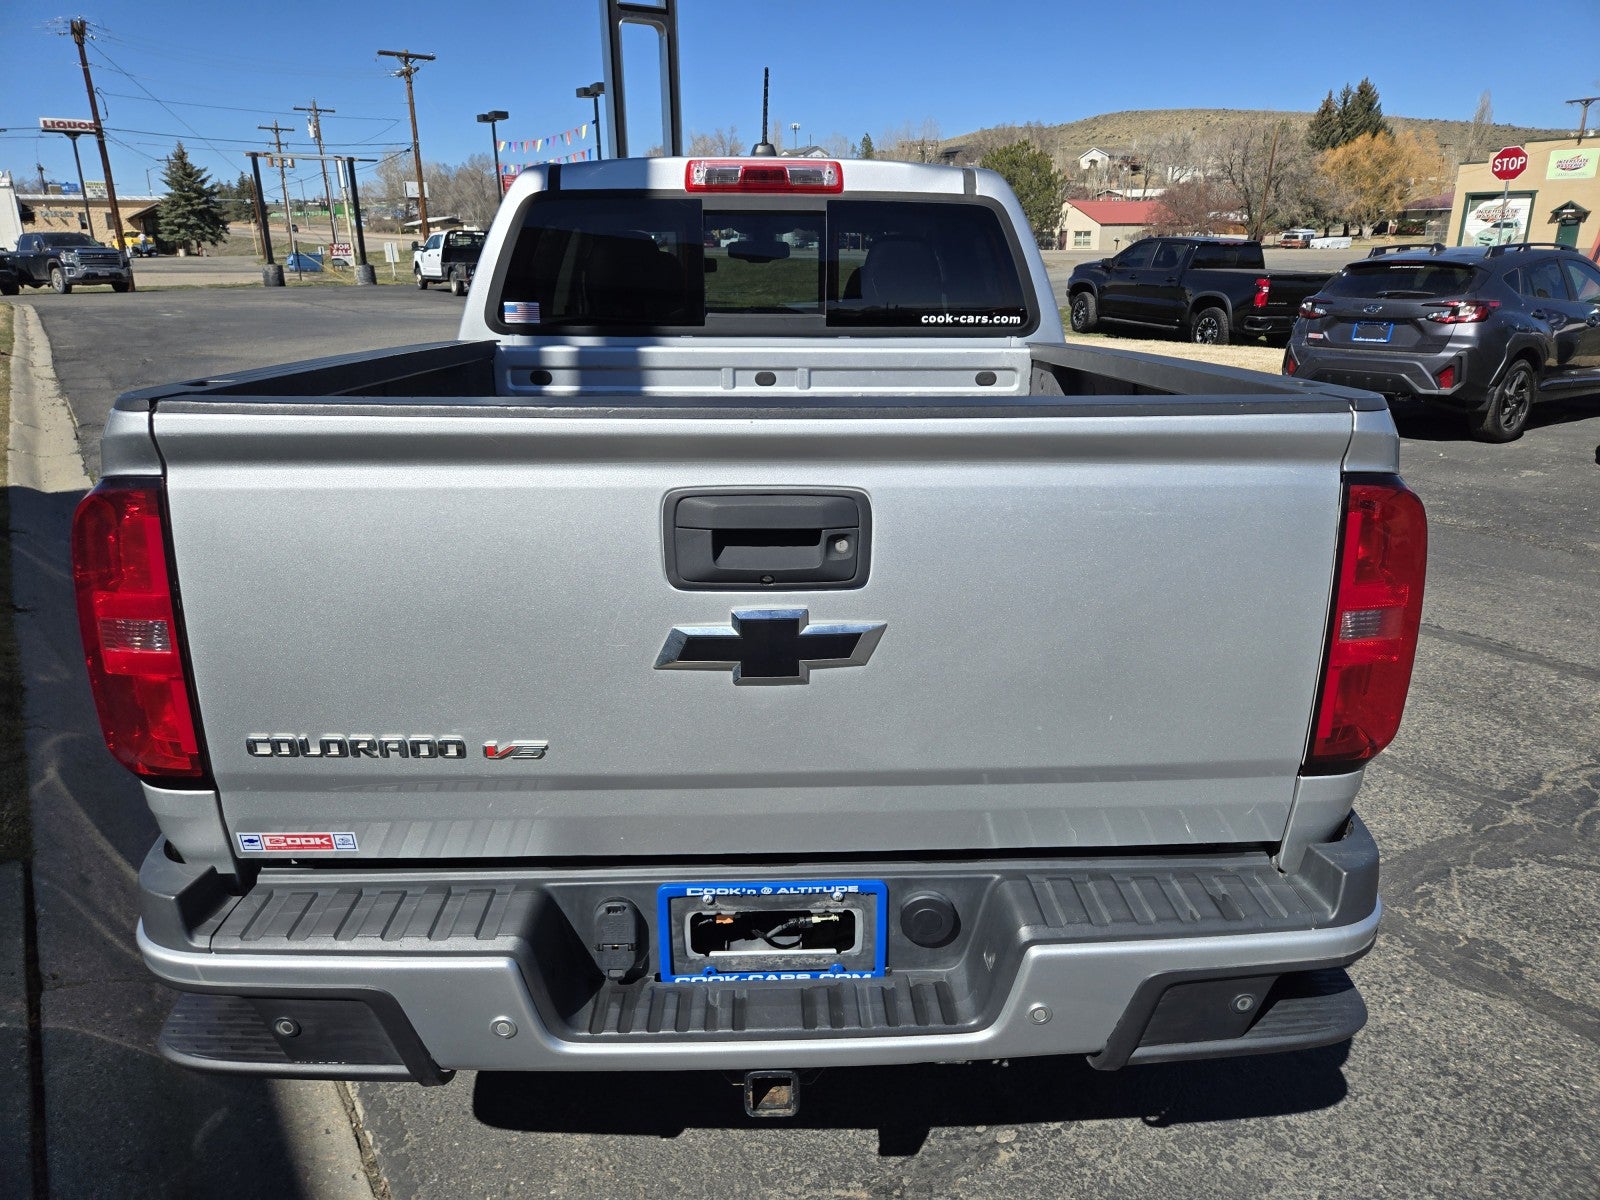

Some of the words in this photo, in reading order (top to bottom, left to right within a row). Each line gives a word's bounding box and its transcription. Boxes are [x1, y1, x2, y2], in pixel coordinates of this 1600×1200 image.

[42, 120, 97, 130] LIQUOR
[1493, 156, 1526, 172] STOP
[332, 249, 352, 257] SALE
[921, 313, 1021, 324] cook-cars.com
[246, 733, 467, 759] COLORADO
[482, 739, 549, 760] V6
[263, 836, 332, 847] COOK
[776, 886, 859, 895] ALTITUDE
